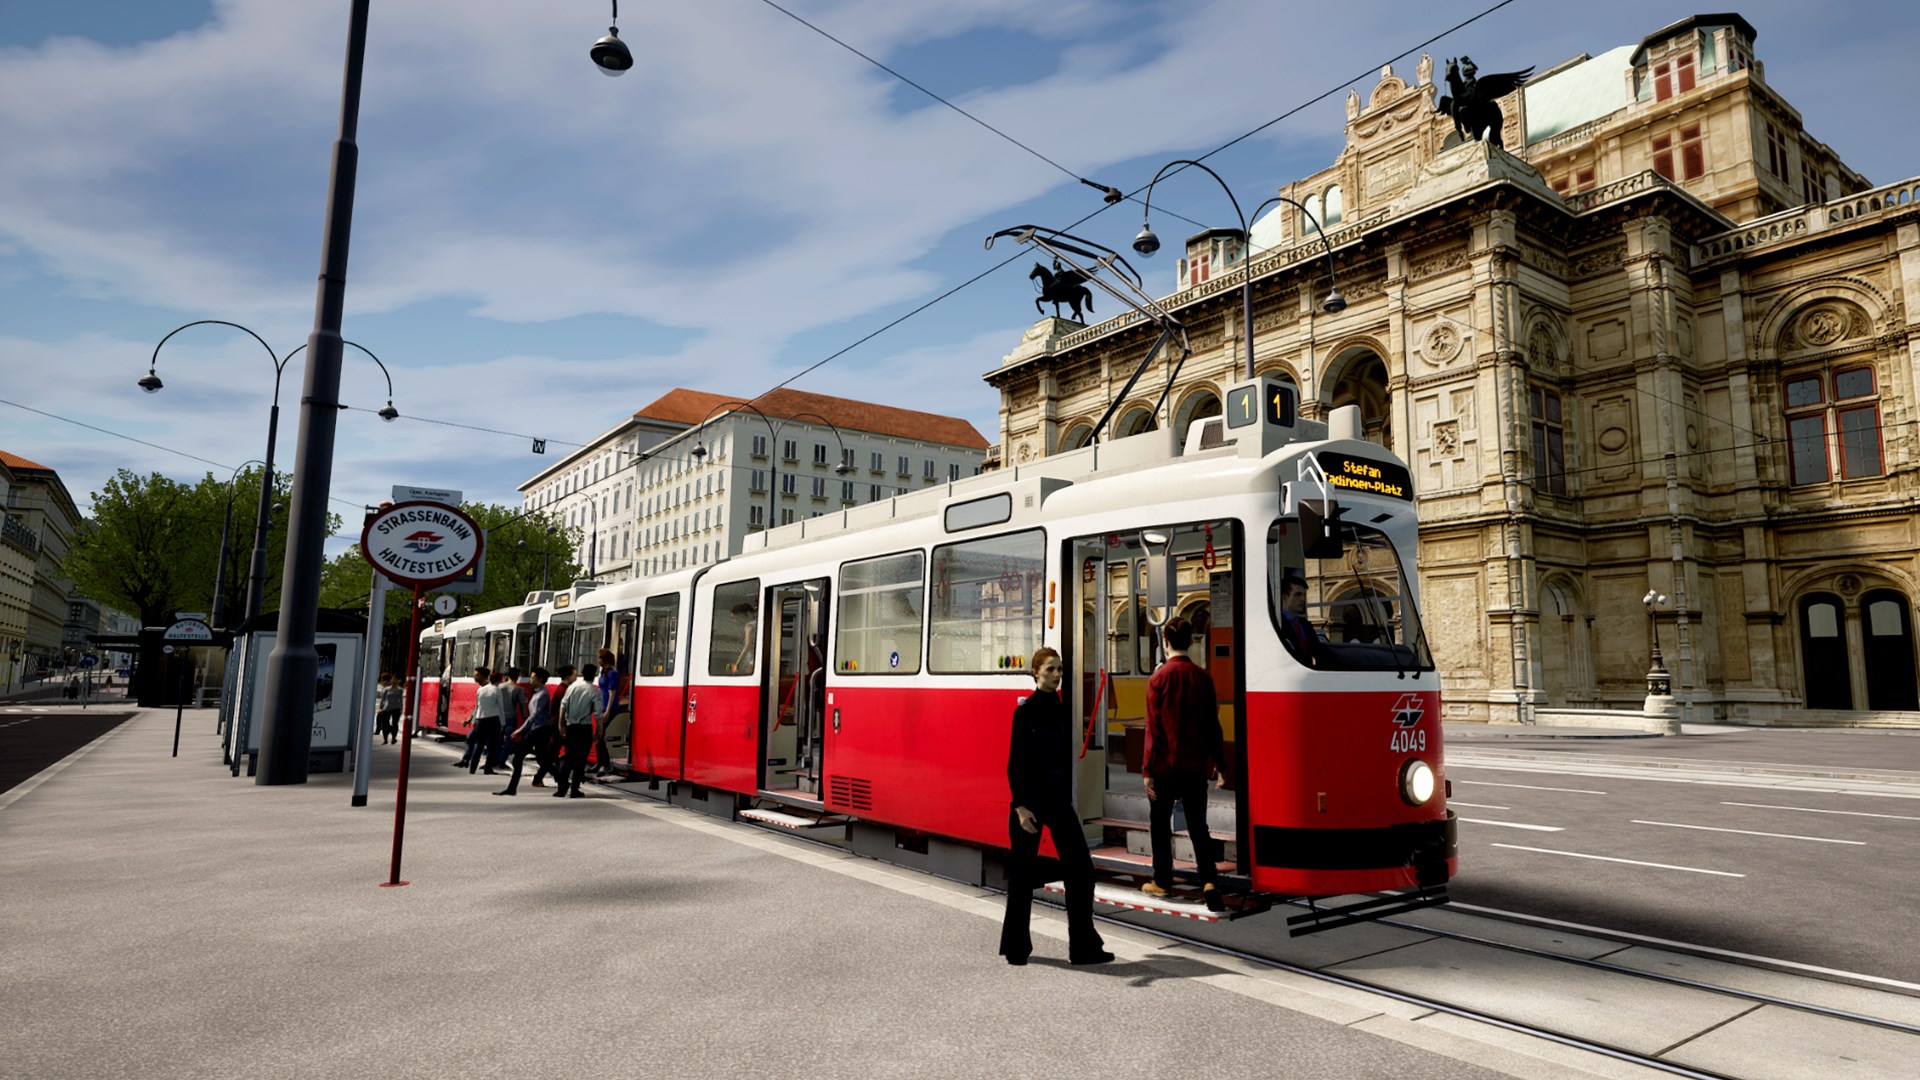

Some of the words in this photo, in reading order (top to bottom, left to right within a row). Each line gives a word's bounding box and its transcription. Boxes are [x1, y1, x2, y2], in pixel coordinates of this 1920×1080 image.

[1241, 393, 1249, 420] 1
[1272, 393, 1281, 420] 1
[533, 441, 546, 453] W
[1343, 460, 1382, 479] Stefan
[377, 510, 471, 541] STRASSENBAHN
[378, 547, 466, 574] HALTESTELLE
[442, 600, 448, 611] 1
[1390, 729, 1427, 753] 4049
